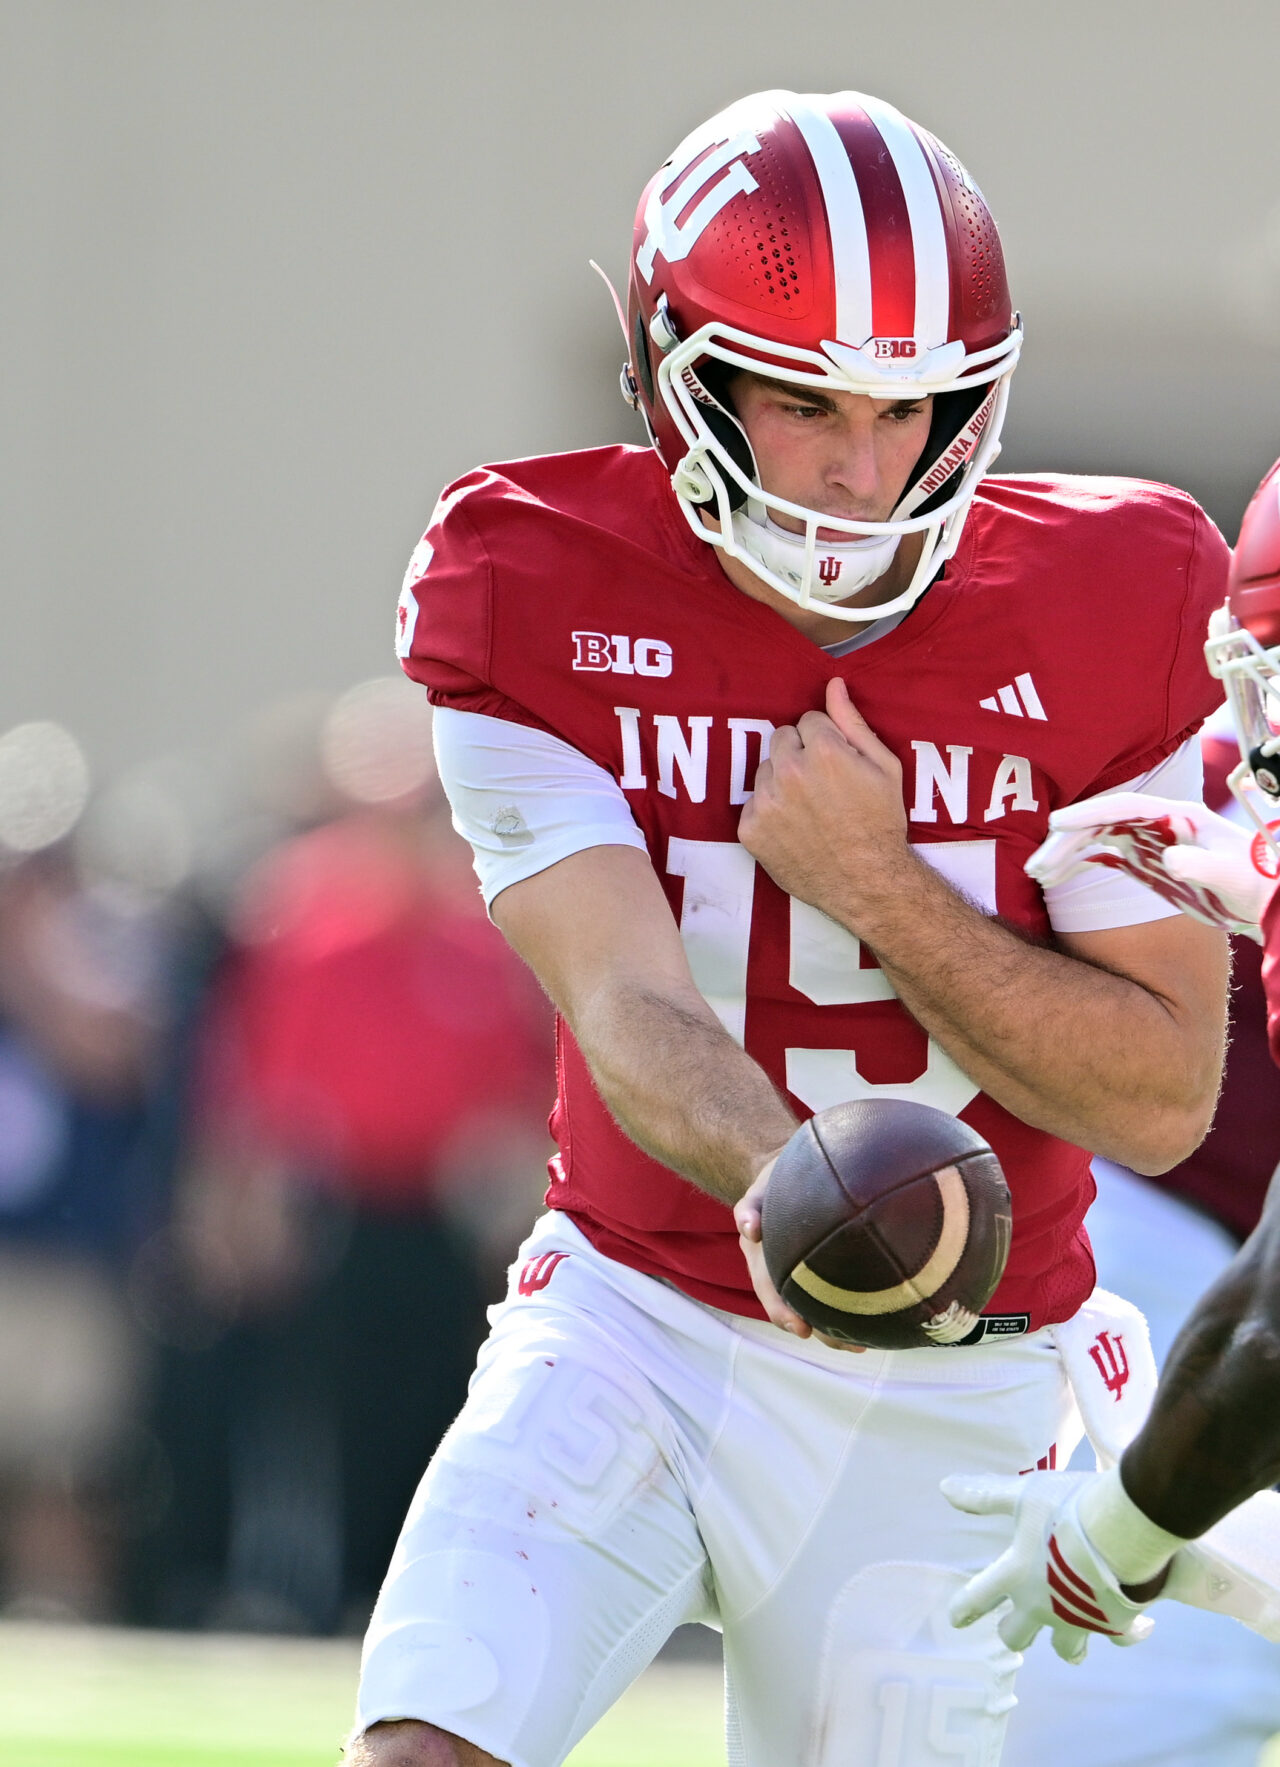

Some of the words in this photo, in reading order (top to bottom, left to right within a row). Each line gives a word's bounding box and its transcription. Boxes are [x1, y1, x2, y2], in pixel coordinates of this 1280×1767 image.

[919, 438, 972, 494] INDIANA
[614, 706, 1039, 825] INDNA
[666, 836, 998, 1124] 15
